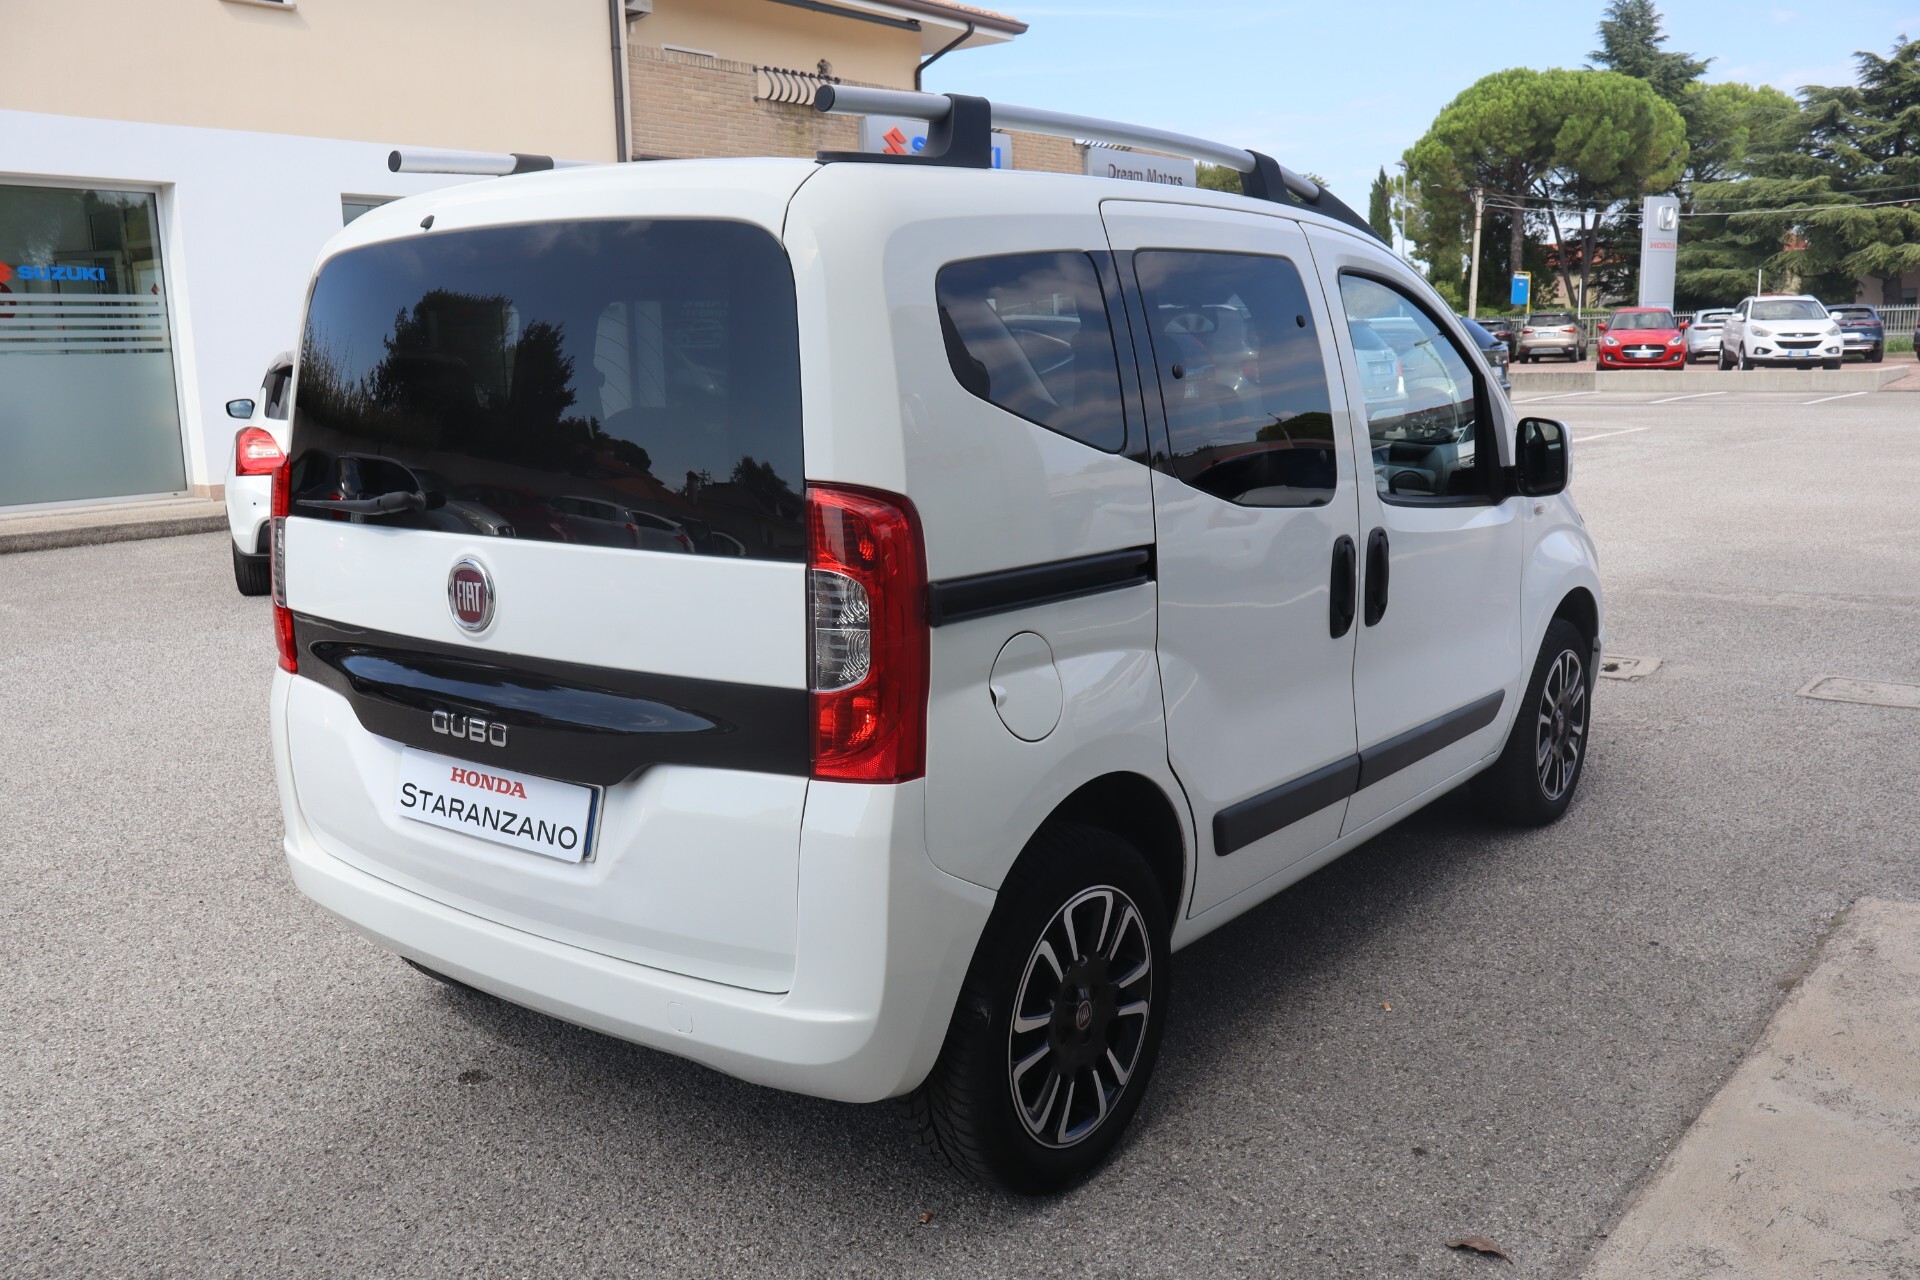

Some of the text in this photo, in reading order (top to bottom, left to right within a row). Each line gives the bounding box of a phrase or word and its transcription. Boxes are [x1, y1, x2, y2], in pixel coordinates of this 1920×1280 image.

[1108, 164, 1183, 186] Dream Motors
[1650, 241, 1676, 250] HONDA
[17, 265, 106, 281] SUZUKI
[456, 580, 481, 612] FIAT
[431, 709, 509, 748] QUBO
[450, 766, 527, 799] HONDA
[400, 782, 578, 850] STARANZANO
